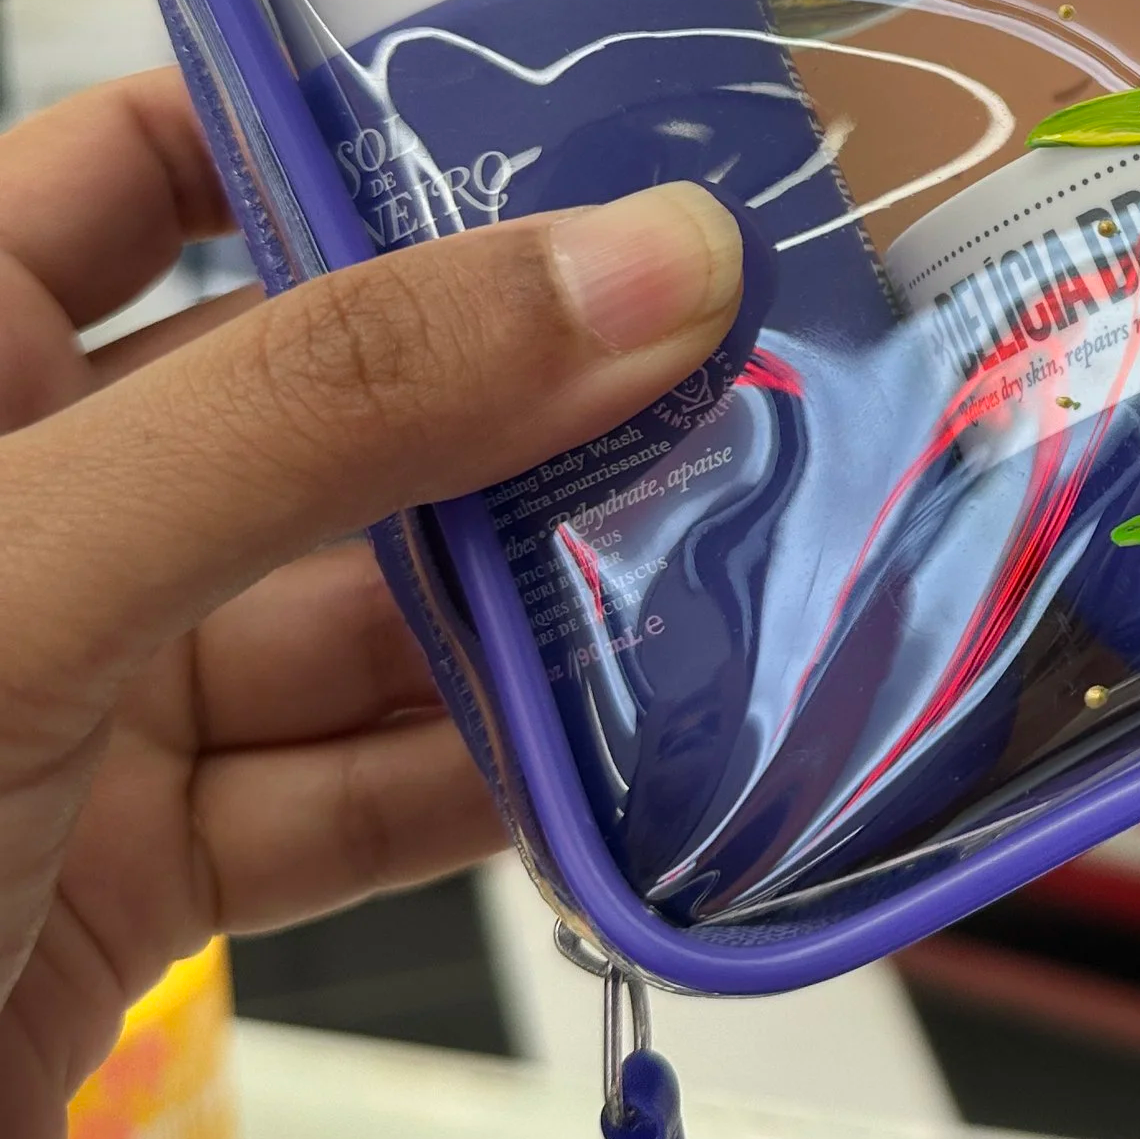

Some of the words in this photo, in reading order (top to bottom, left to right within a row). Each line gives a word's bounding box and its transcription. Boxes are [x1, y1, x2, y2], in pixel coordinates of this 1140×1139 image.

[337, 114, 419, 200] SOL
[370, 171, 397, 198] DE
[1001, 376, 1024, 403] dry
[1026, 359, 1065, 387] skin,
[1065, 319, 1130, 368] repairs
[653, 402, 691, 429] SANS
[515, 496, 553, 519] ultra
[554, 439, 672, 503] nourrissante
[540, 451, 586, 483] Body
[586, 424, 644, 460] Wash
[668, 445, 733, 492] apaise
[560, 617, 580, 636] DE
